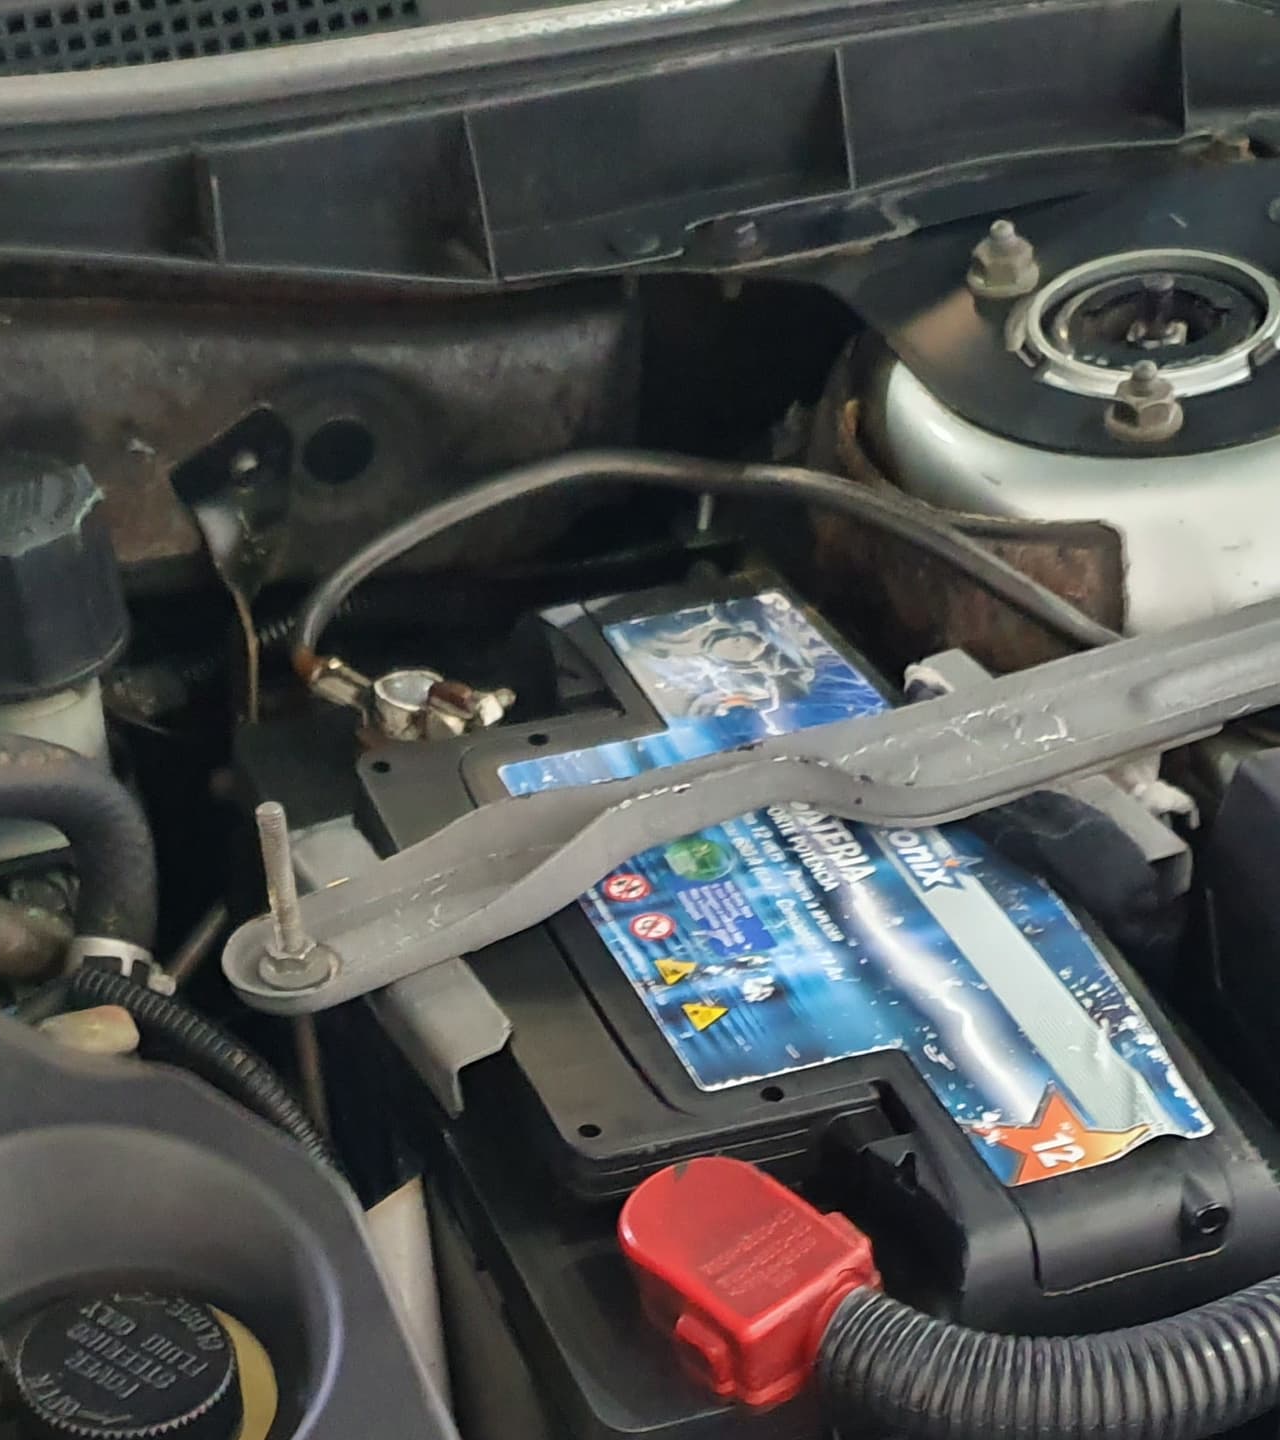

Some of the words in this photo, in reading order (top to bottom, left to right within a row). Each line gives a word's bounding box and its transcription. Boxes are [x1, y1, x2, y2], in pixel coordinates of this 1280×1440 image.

[766, 807, 796, 837] ORTE
[788, 801, 877, 884] ATERIA
[883, 829, 954, 887] onix
[1031, 1131, 1086, 1168] 12
[79, 1300, 138, 1337] ONLY
[64, 1349, 140, 1399] POWER
[66, 1322, 177, 1390] STEERING
[140, 1332, 209, 1378] FLUID
